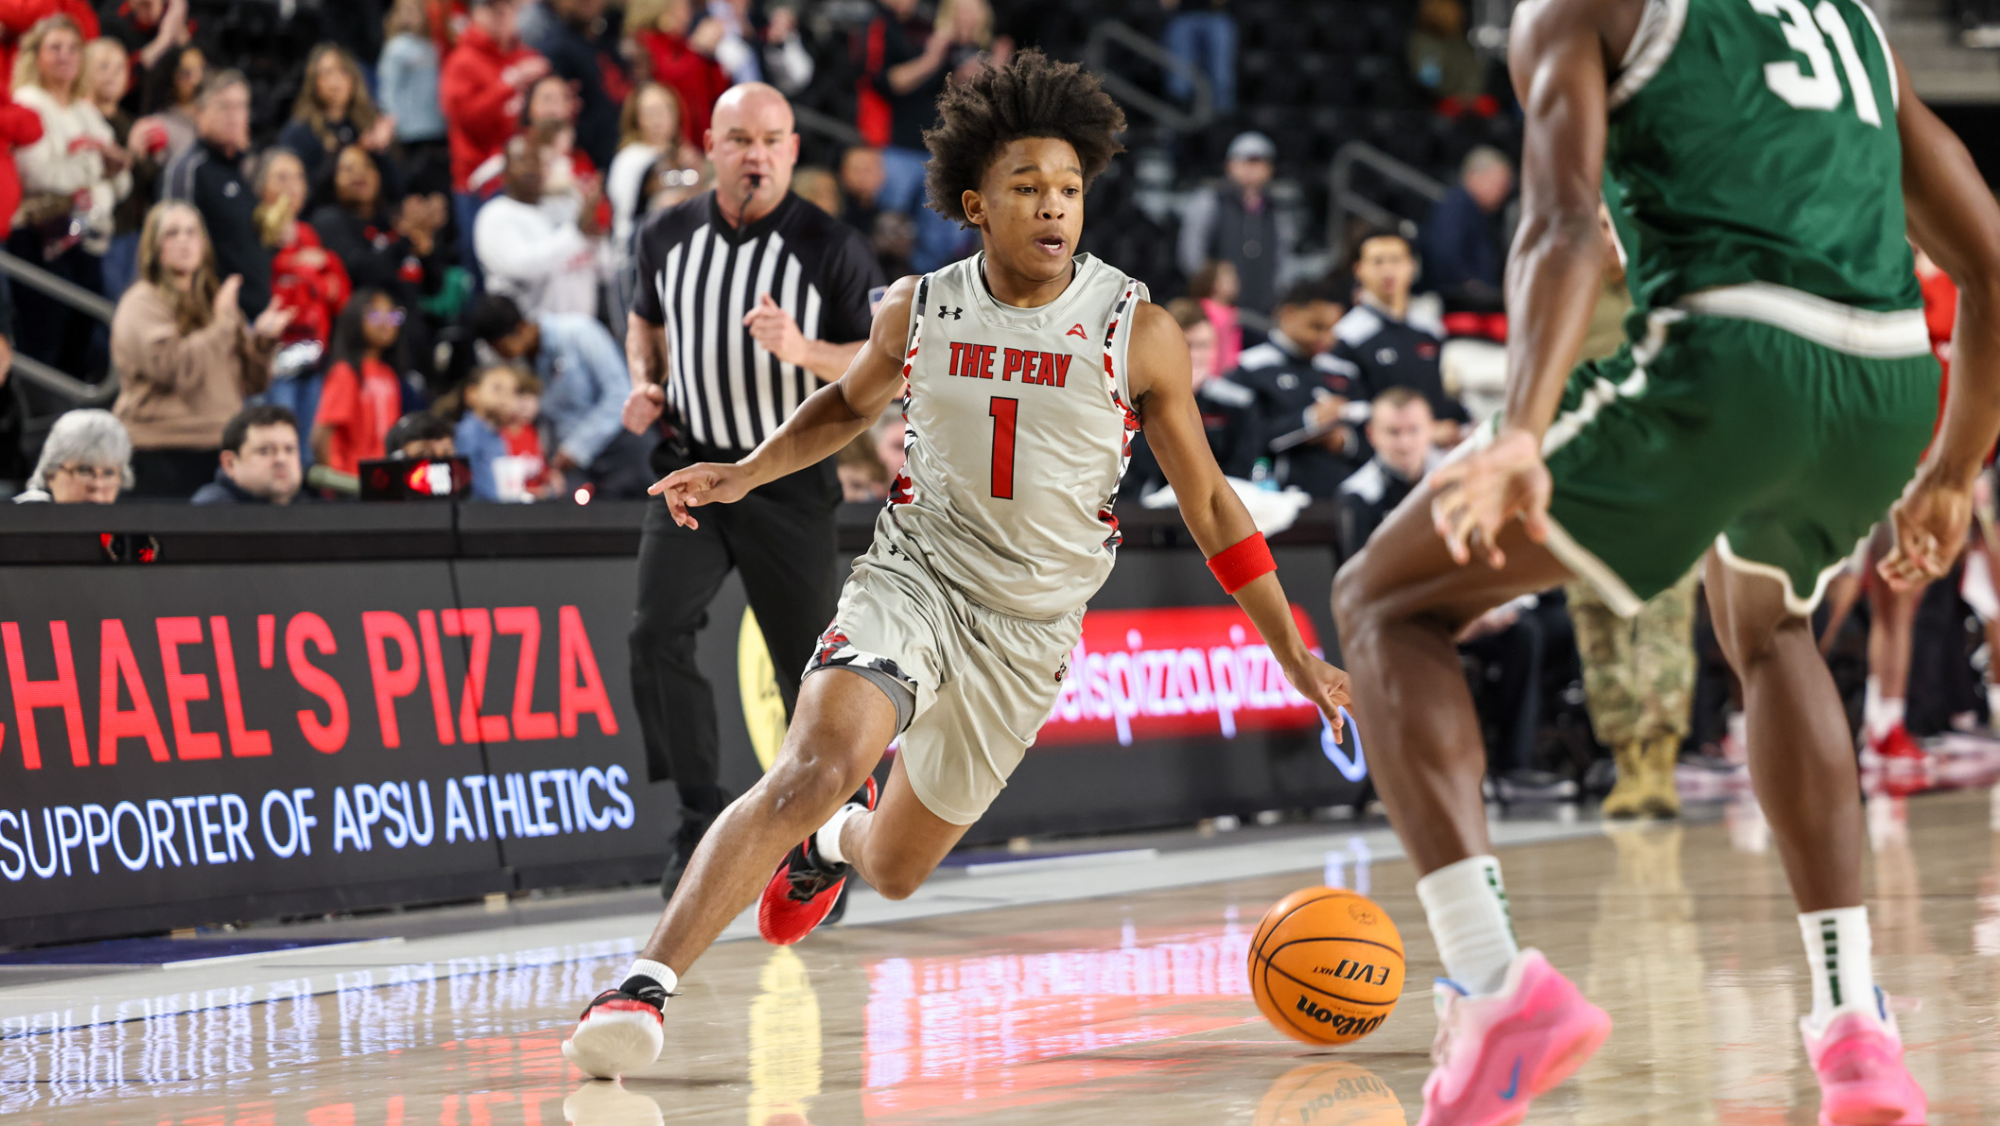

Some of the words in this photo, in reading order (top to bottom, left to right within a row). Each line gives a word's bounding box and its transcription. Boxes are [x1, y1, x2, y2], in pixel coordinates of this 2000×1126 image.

[1748, 0, 1883, 130] 31
[949, 341, 997, 380] THE
[1002, 347, 1073, 388] PEAY
[989, 395, 1018, 500] 1
[0, 609, 349, 770] HAEL'S
[361, 604, 619, 748] PIZZA
[0, 793, 255, 881] SUPPORTER
[260, 787, 318, 858] OF
[334, 778, 434, 853] APSU
[446, 763, 635, 844] ATHLETICS
[1296, 993, 1388, 1036] Wilson
[1333, 958, 1391, 986] EVO
